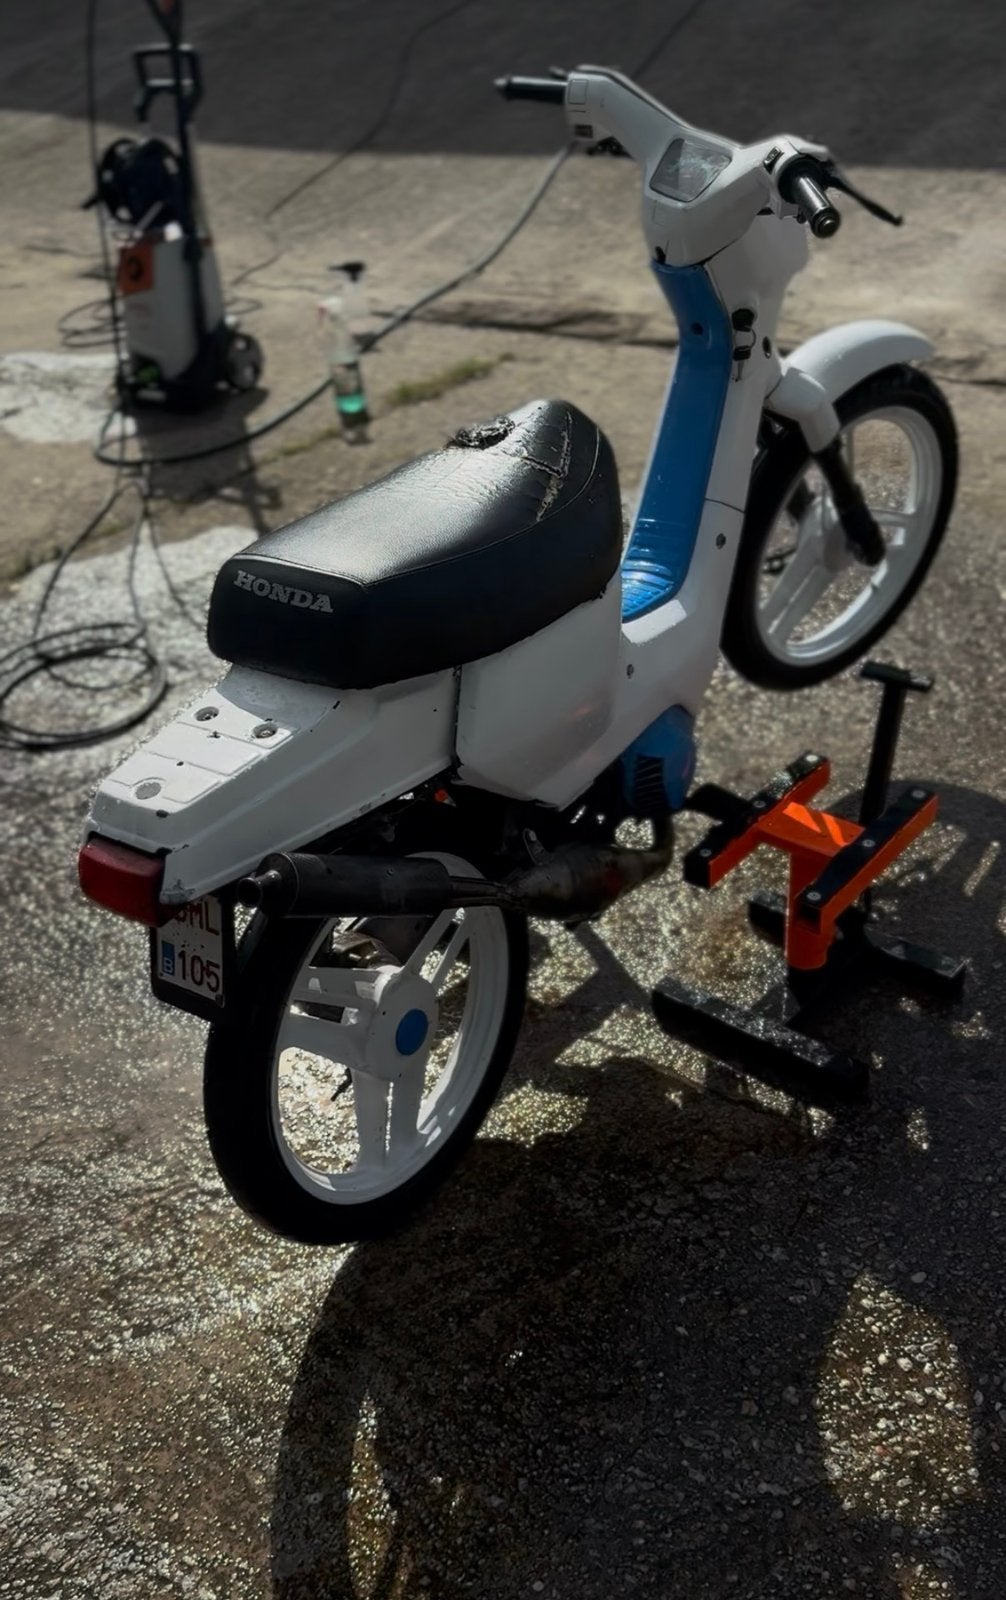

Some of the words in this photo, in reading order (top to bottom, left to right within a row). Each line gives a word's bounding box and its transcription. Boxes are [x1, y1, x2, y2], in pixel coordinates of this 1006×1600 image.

[233, 570, 333, 613] HONDA
[164, 957, 173, 974] B
[178, 950, 220, 993] 105
